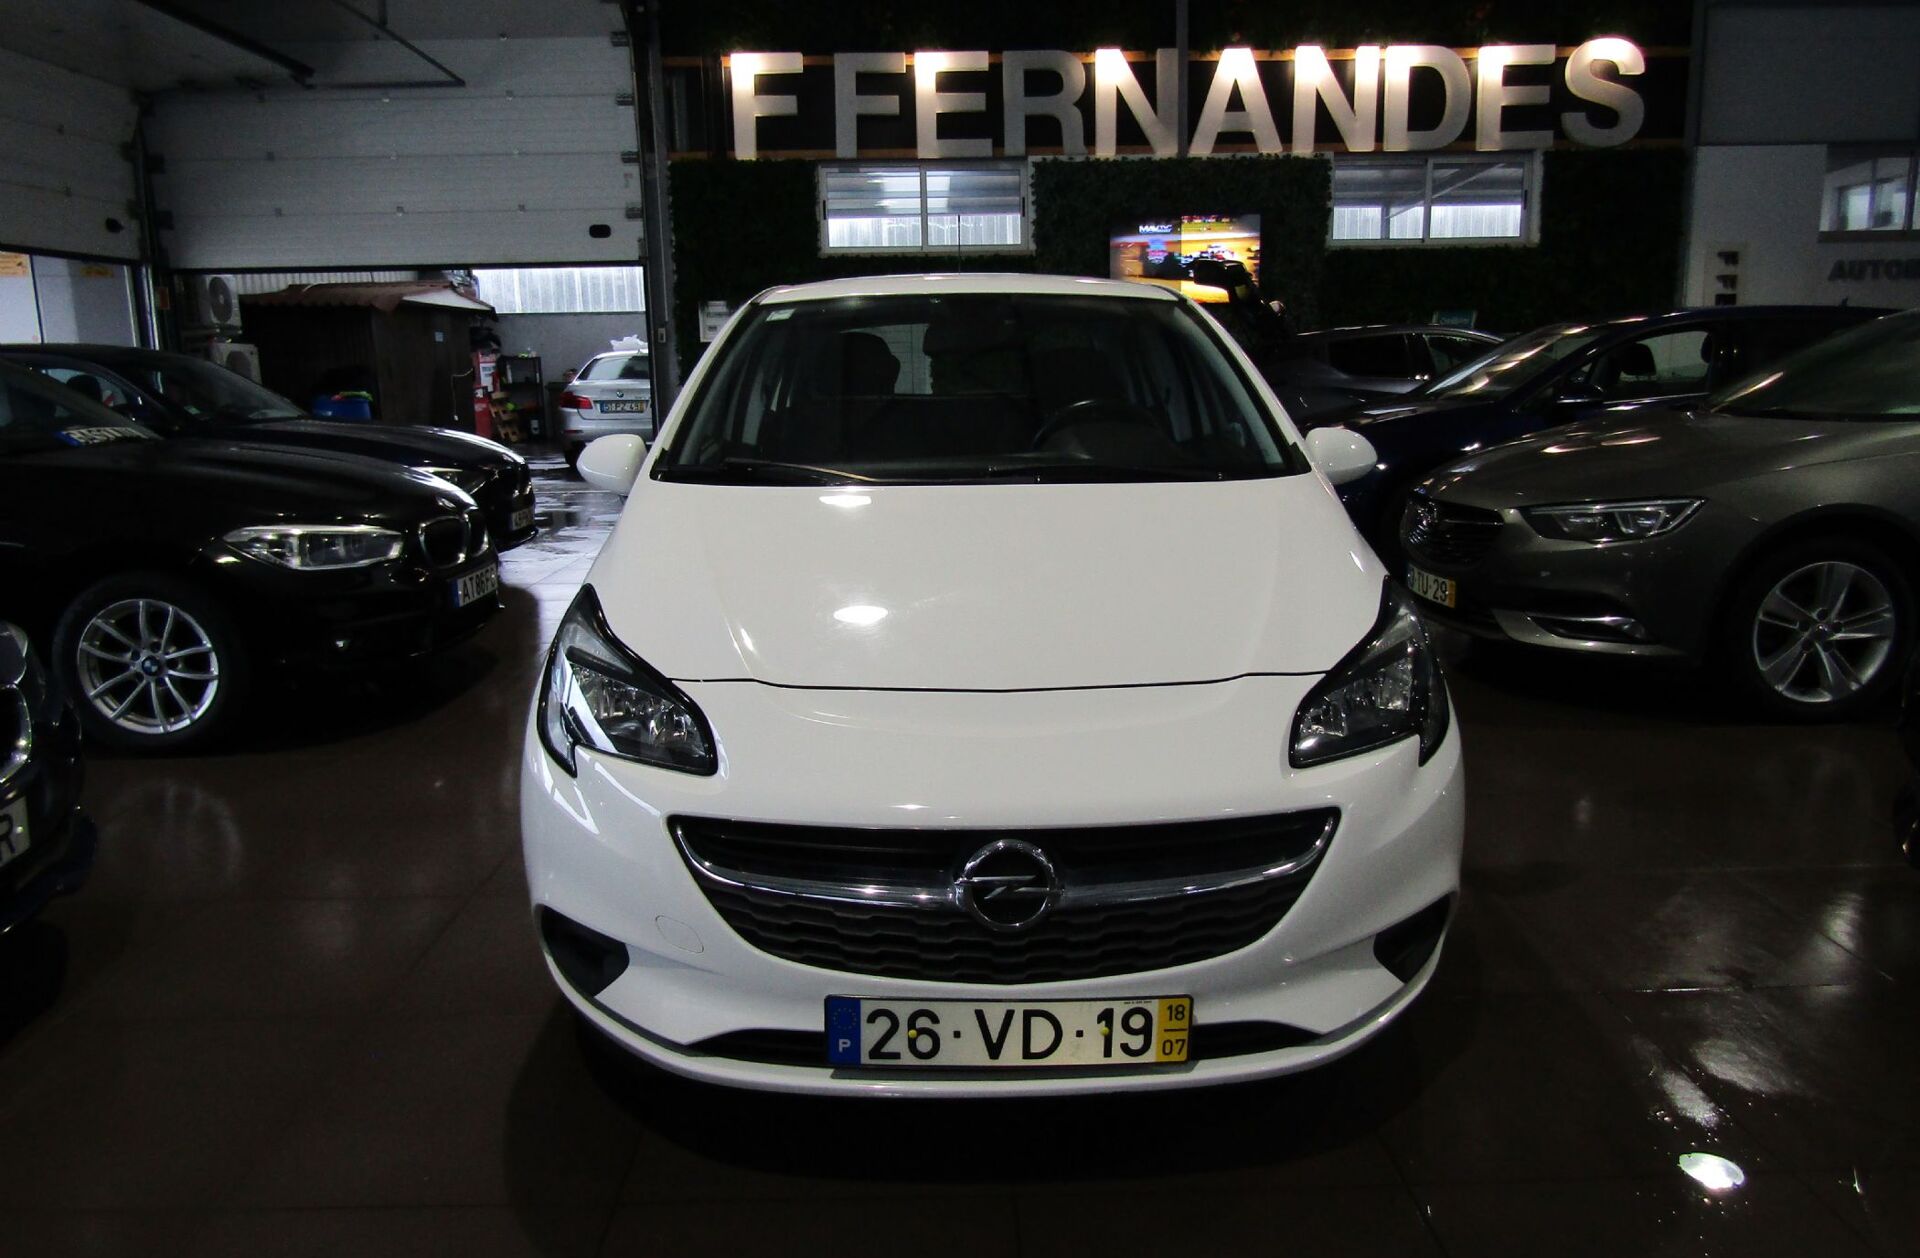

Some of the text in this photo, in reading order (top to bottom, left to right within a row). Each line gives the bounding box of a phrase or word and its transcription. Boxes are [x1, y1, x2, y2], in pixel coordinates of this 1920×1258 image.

[730, 37, 1645, 161] F FERNANDES
[1167, 1004, 1185, 1021] 18
[838, 1038, 852, 1053] P
[1162, 1038, 1186, 1056] 07
